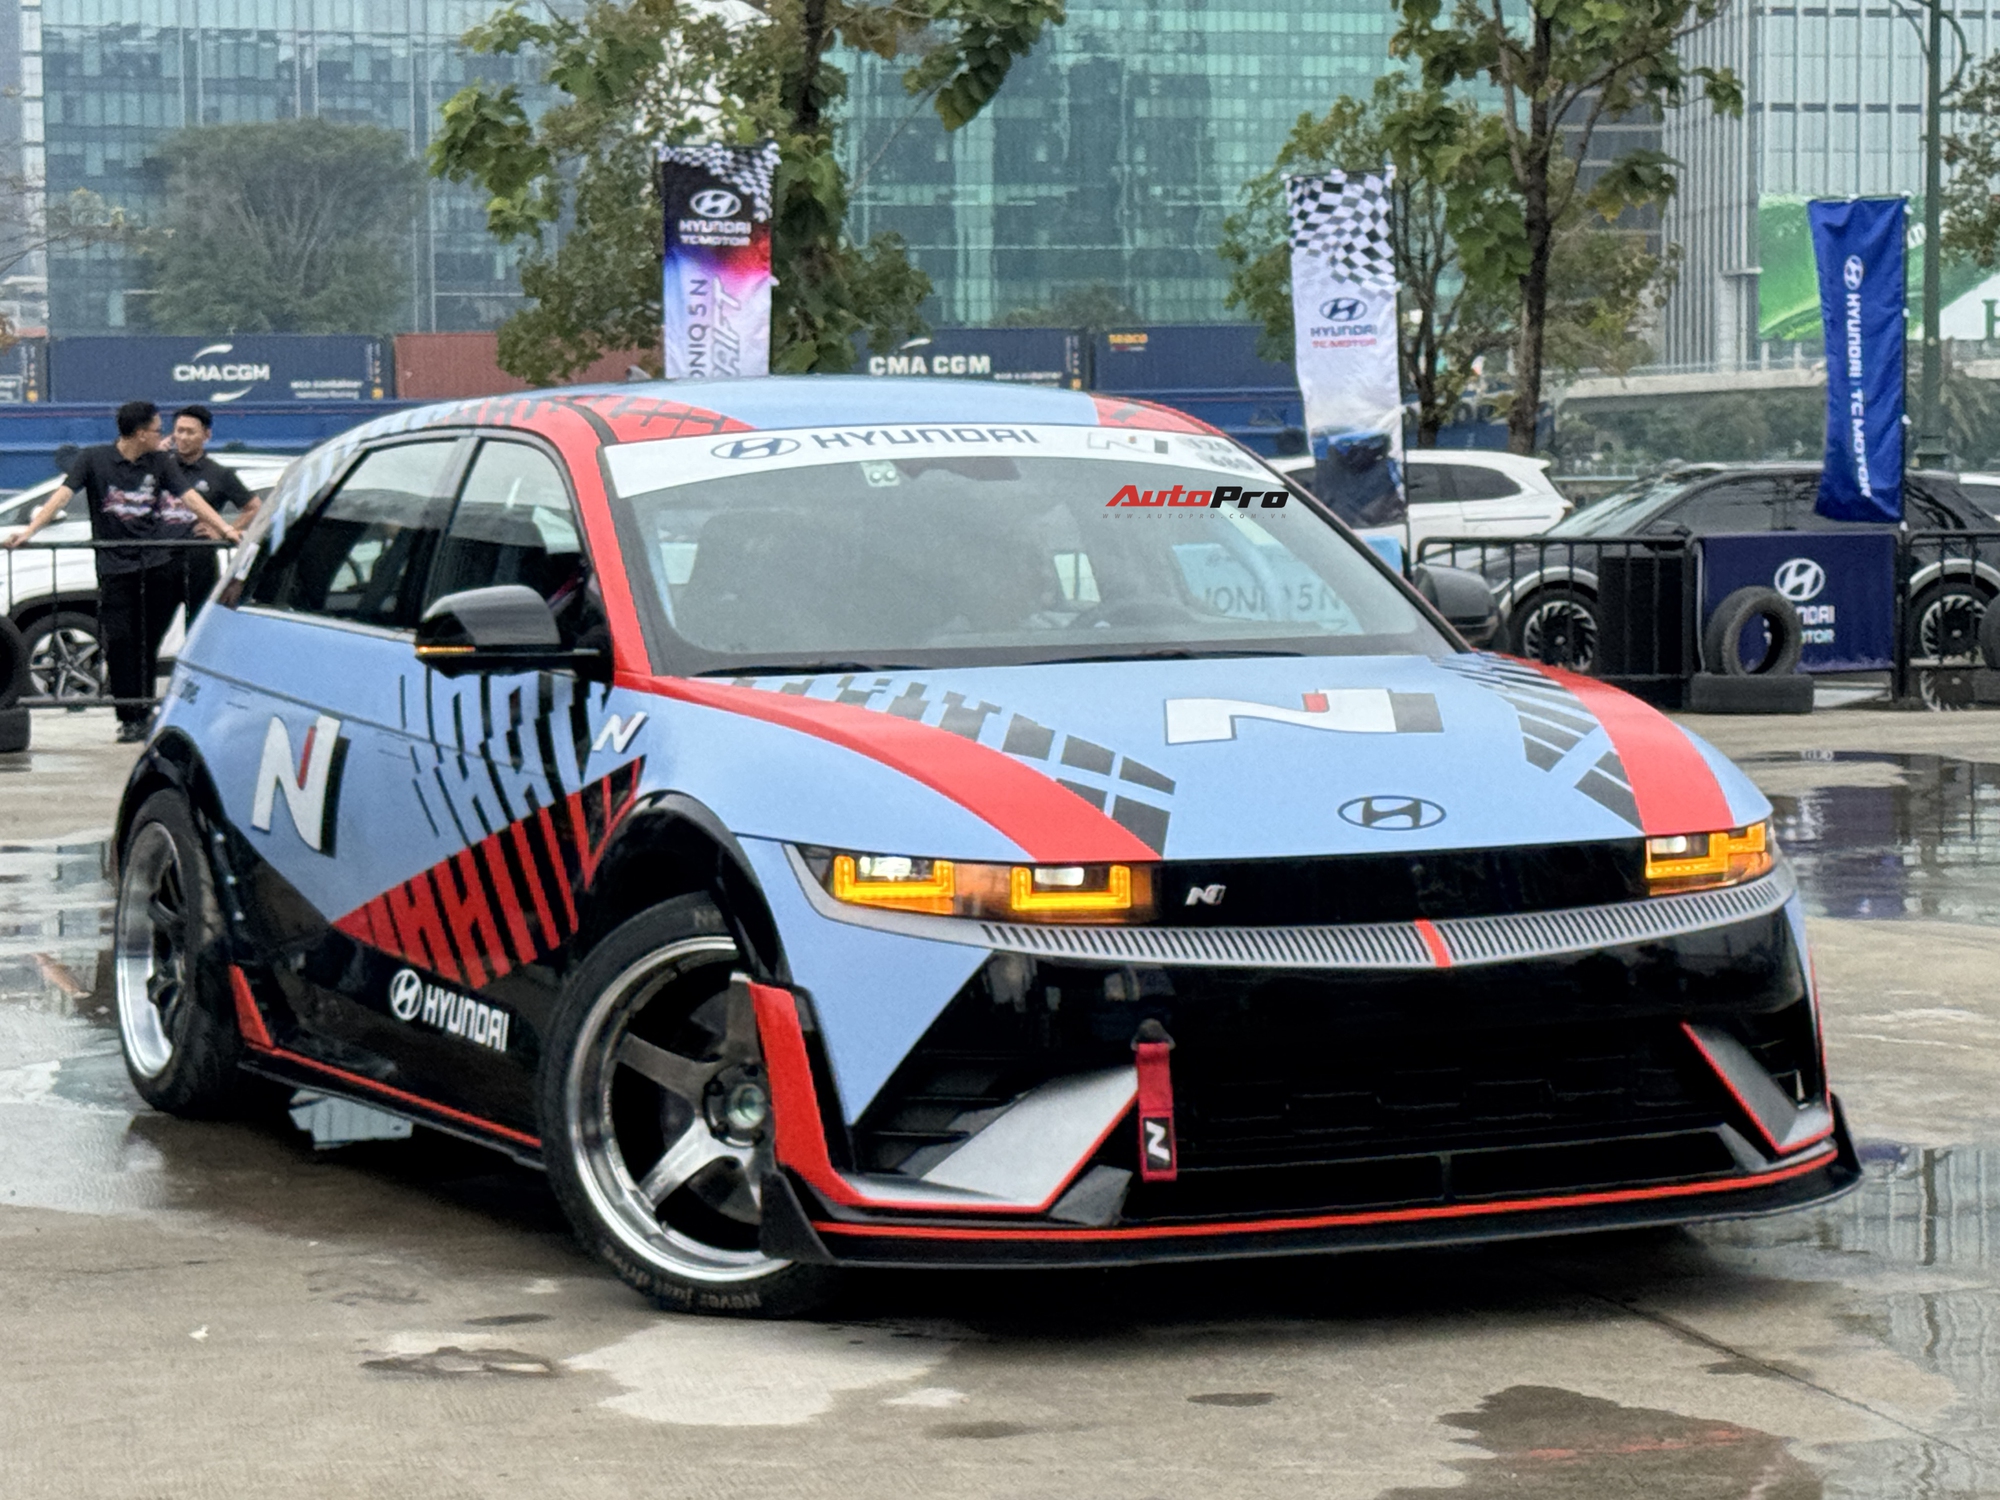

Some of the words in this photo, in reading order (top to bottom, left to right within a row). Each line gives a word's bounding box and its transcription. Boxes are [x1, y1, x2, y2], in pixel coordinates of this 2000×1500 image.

[678, 219, 752, 235] HYUNDAI
[688, 279, 708, 297] N
[687, 303, 707, 317] 5
[1310, 324, 1378, 337] HYUNDAI
[1845, 293, 1863, 378] HYUNDAI
[868, 356, 927, 375] CMA
[933, 355, 991, 374] CGM
[1850, 388, 1865, 416] TC
[811, 428, 1041, 449] HYUNDAI
[1851, 418, 1873, 499] MOTOR
[1296, 583, 1313, 612] 5
[251, 714, 351, 859] N
[422, 983, 511, 1053] HYUNDAI
